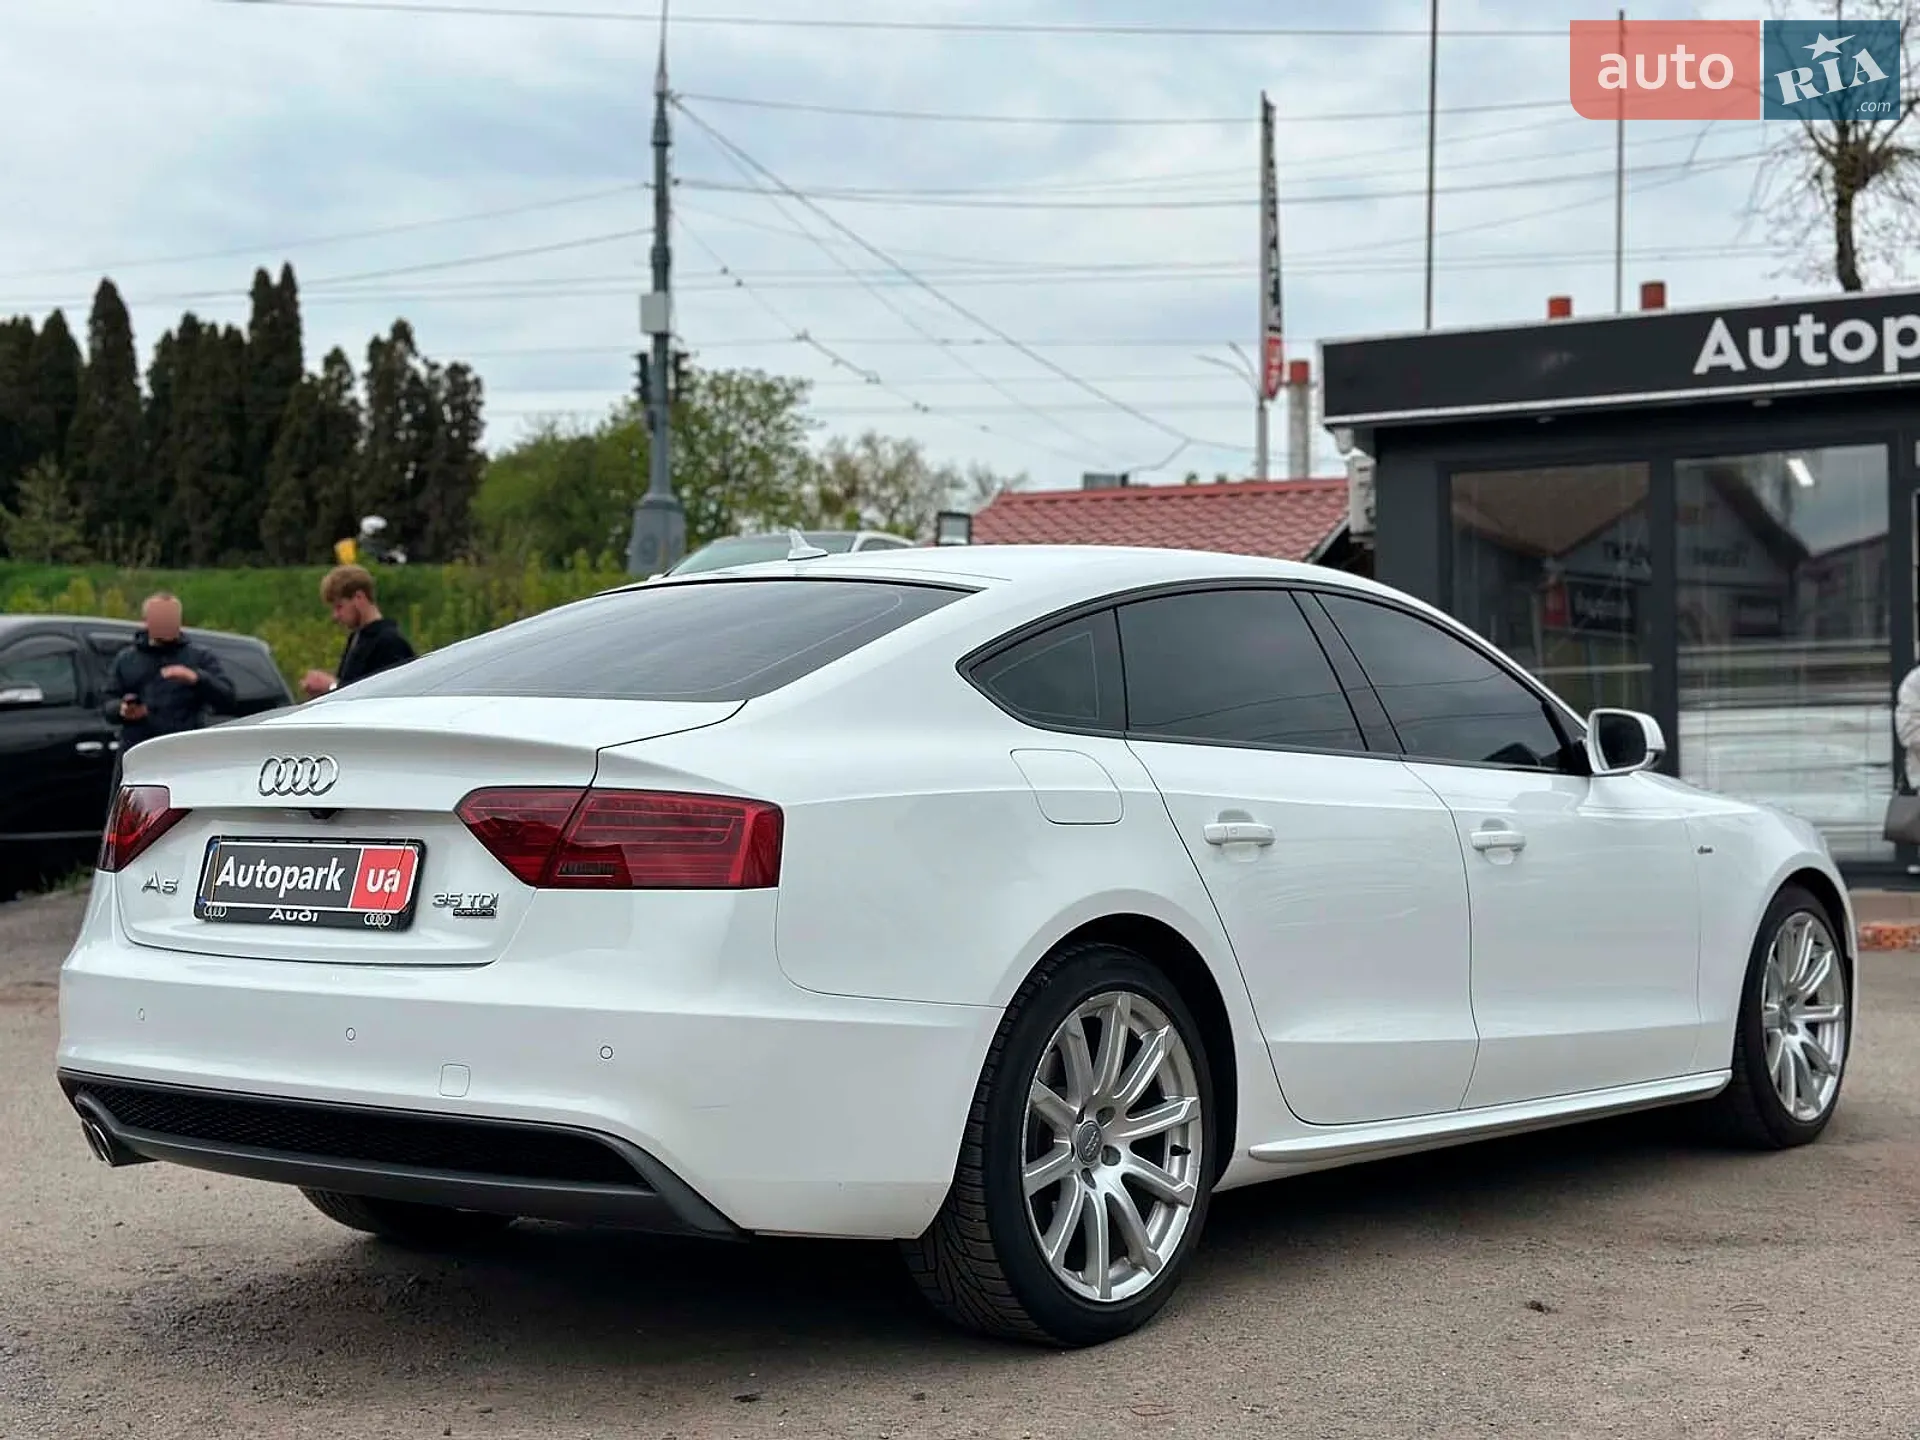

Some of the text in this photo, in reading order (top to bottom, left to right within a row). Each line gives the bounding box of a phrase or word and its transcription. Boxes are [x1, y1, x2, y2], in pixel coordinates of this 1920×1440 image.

[1692, 313, 1920, 375] Autop
[140, 869, 179, 896] A5
[215, 855, 402, 899] Autopark ua
[431, 892, 499, 909] 35 TDI
[268, 907, 319, 922] Audi
